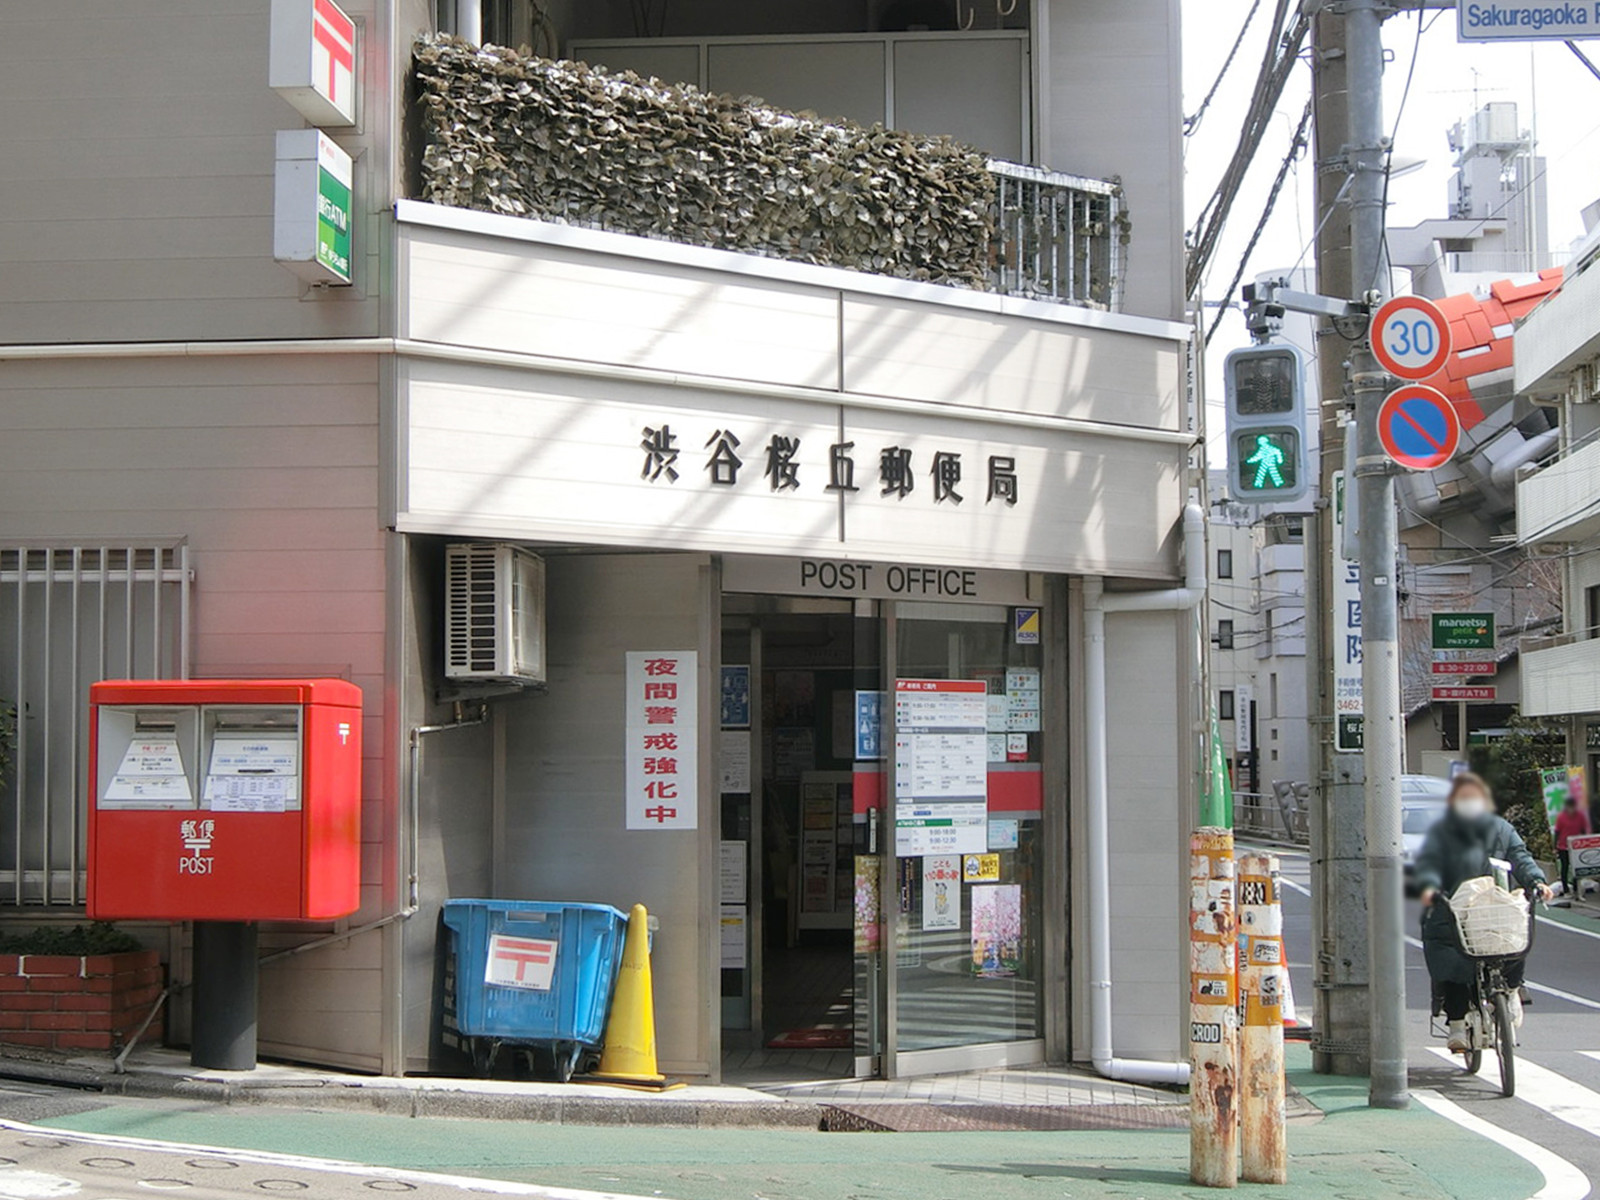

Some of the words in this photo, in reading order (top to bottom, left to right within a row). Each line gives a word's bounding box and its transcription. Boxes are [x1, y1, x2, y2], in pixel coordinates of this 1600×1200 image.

[1468, 3, 1587, 30] Sakuragaoka
[1391, 320, 1434, 356] 30
[641, 424, 1018, 507] 渋谷桜丘郵便局
[801, 561, 872, 592] POST
[887, 565, 977, 597] OFFICE
[1438, 618, 1488, 628] maruetsu
[643, 658, 678, 823] 夜間警戒強化中
[180, 820, 215, 840] 郵便
[180, 857, 214, 874] POST
